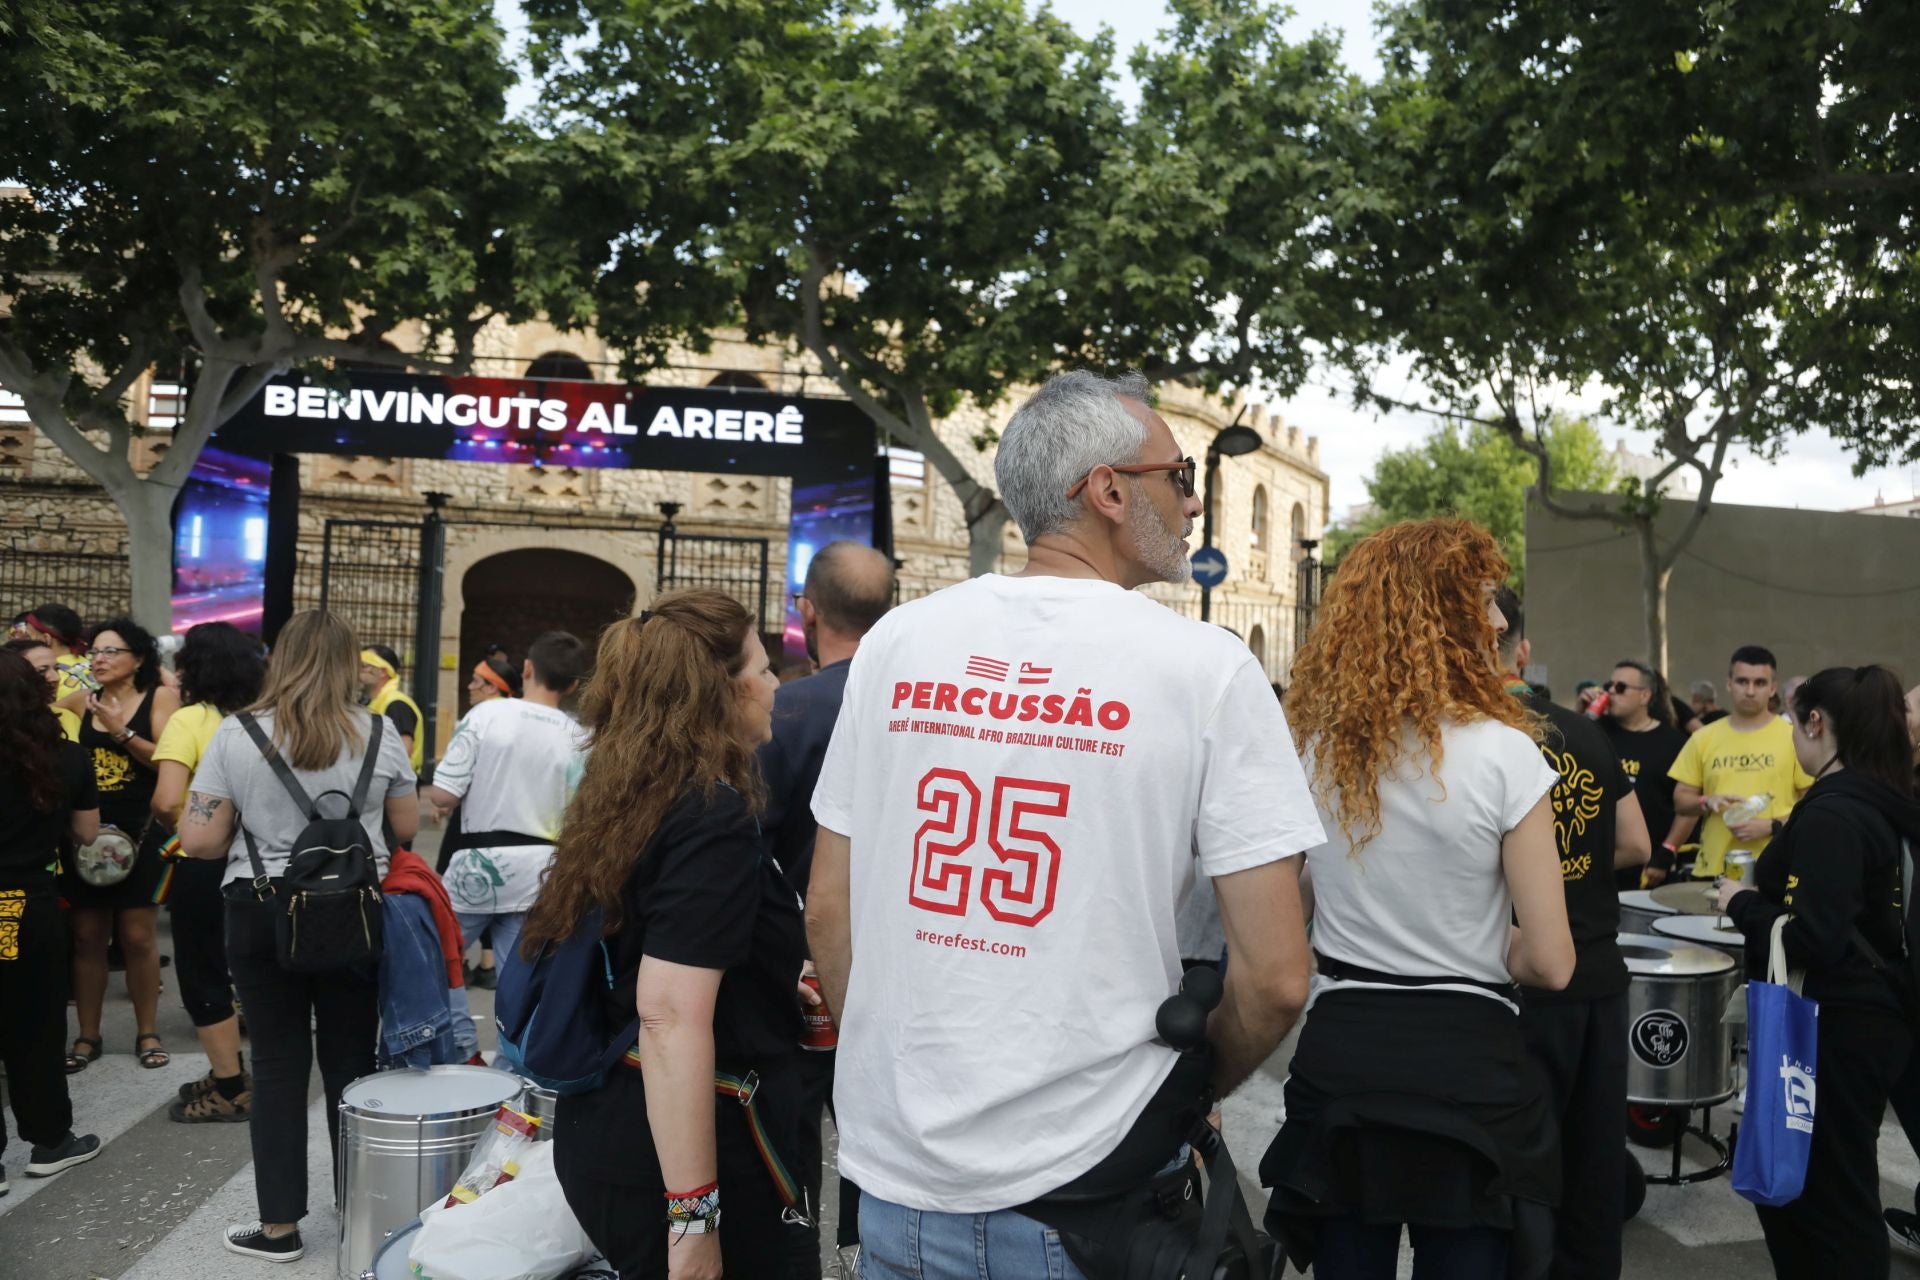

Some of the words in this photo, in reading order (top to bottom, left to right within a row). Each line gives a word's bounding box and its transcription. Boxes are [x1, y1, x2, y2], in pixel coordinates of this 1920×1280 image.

[264, 384, 568, 431] BENVINGUTS
[576, 402, 638, 435] AL
[647, 405, 804, 444] ARERÊ
[891, 681, 1131, 731] PERCUSSÃO
[910, 720, 976, 740] INTERNATIONAL
[978, 728, 1003, 743] AFRO
[1005, 732, 1053, 748] BRAZILIAN
[1055, 738, 1098, 753] CULTURE
[1100, 742, 1125, 757] FEST
[908, 766, 1071, 928] 25
[915, 929, 1027, 958] arerefest.com
